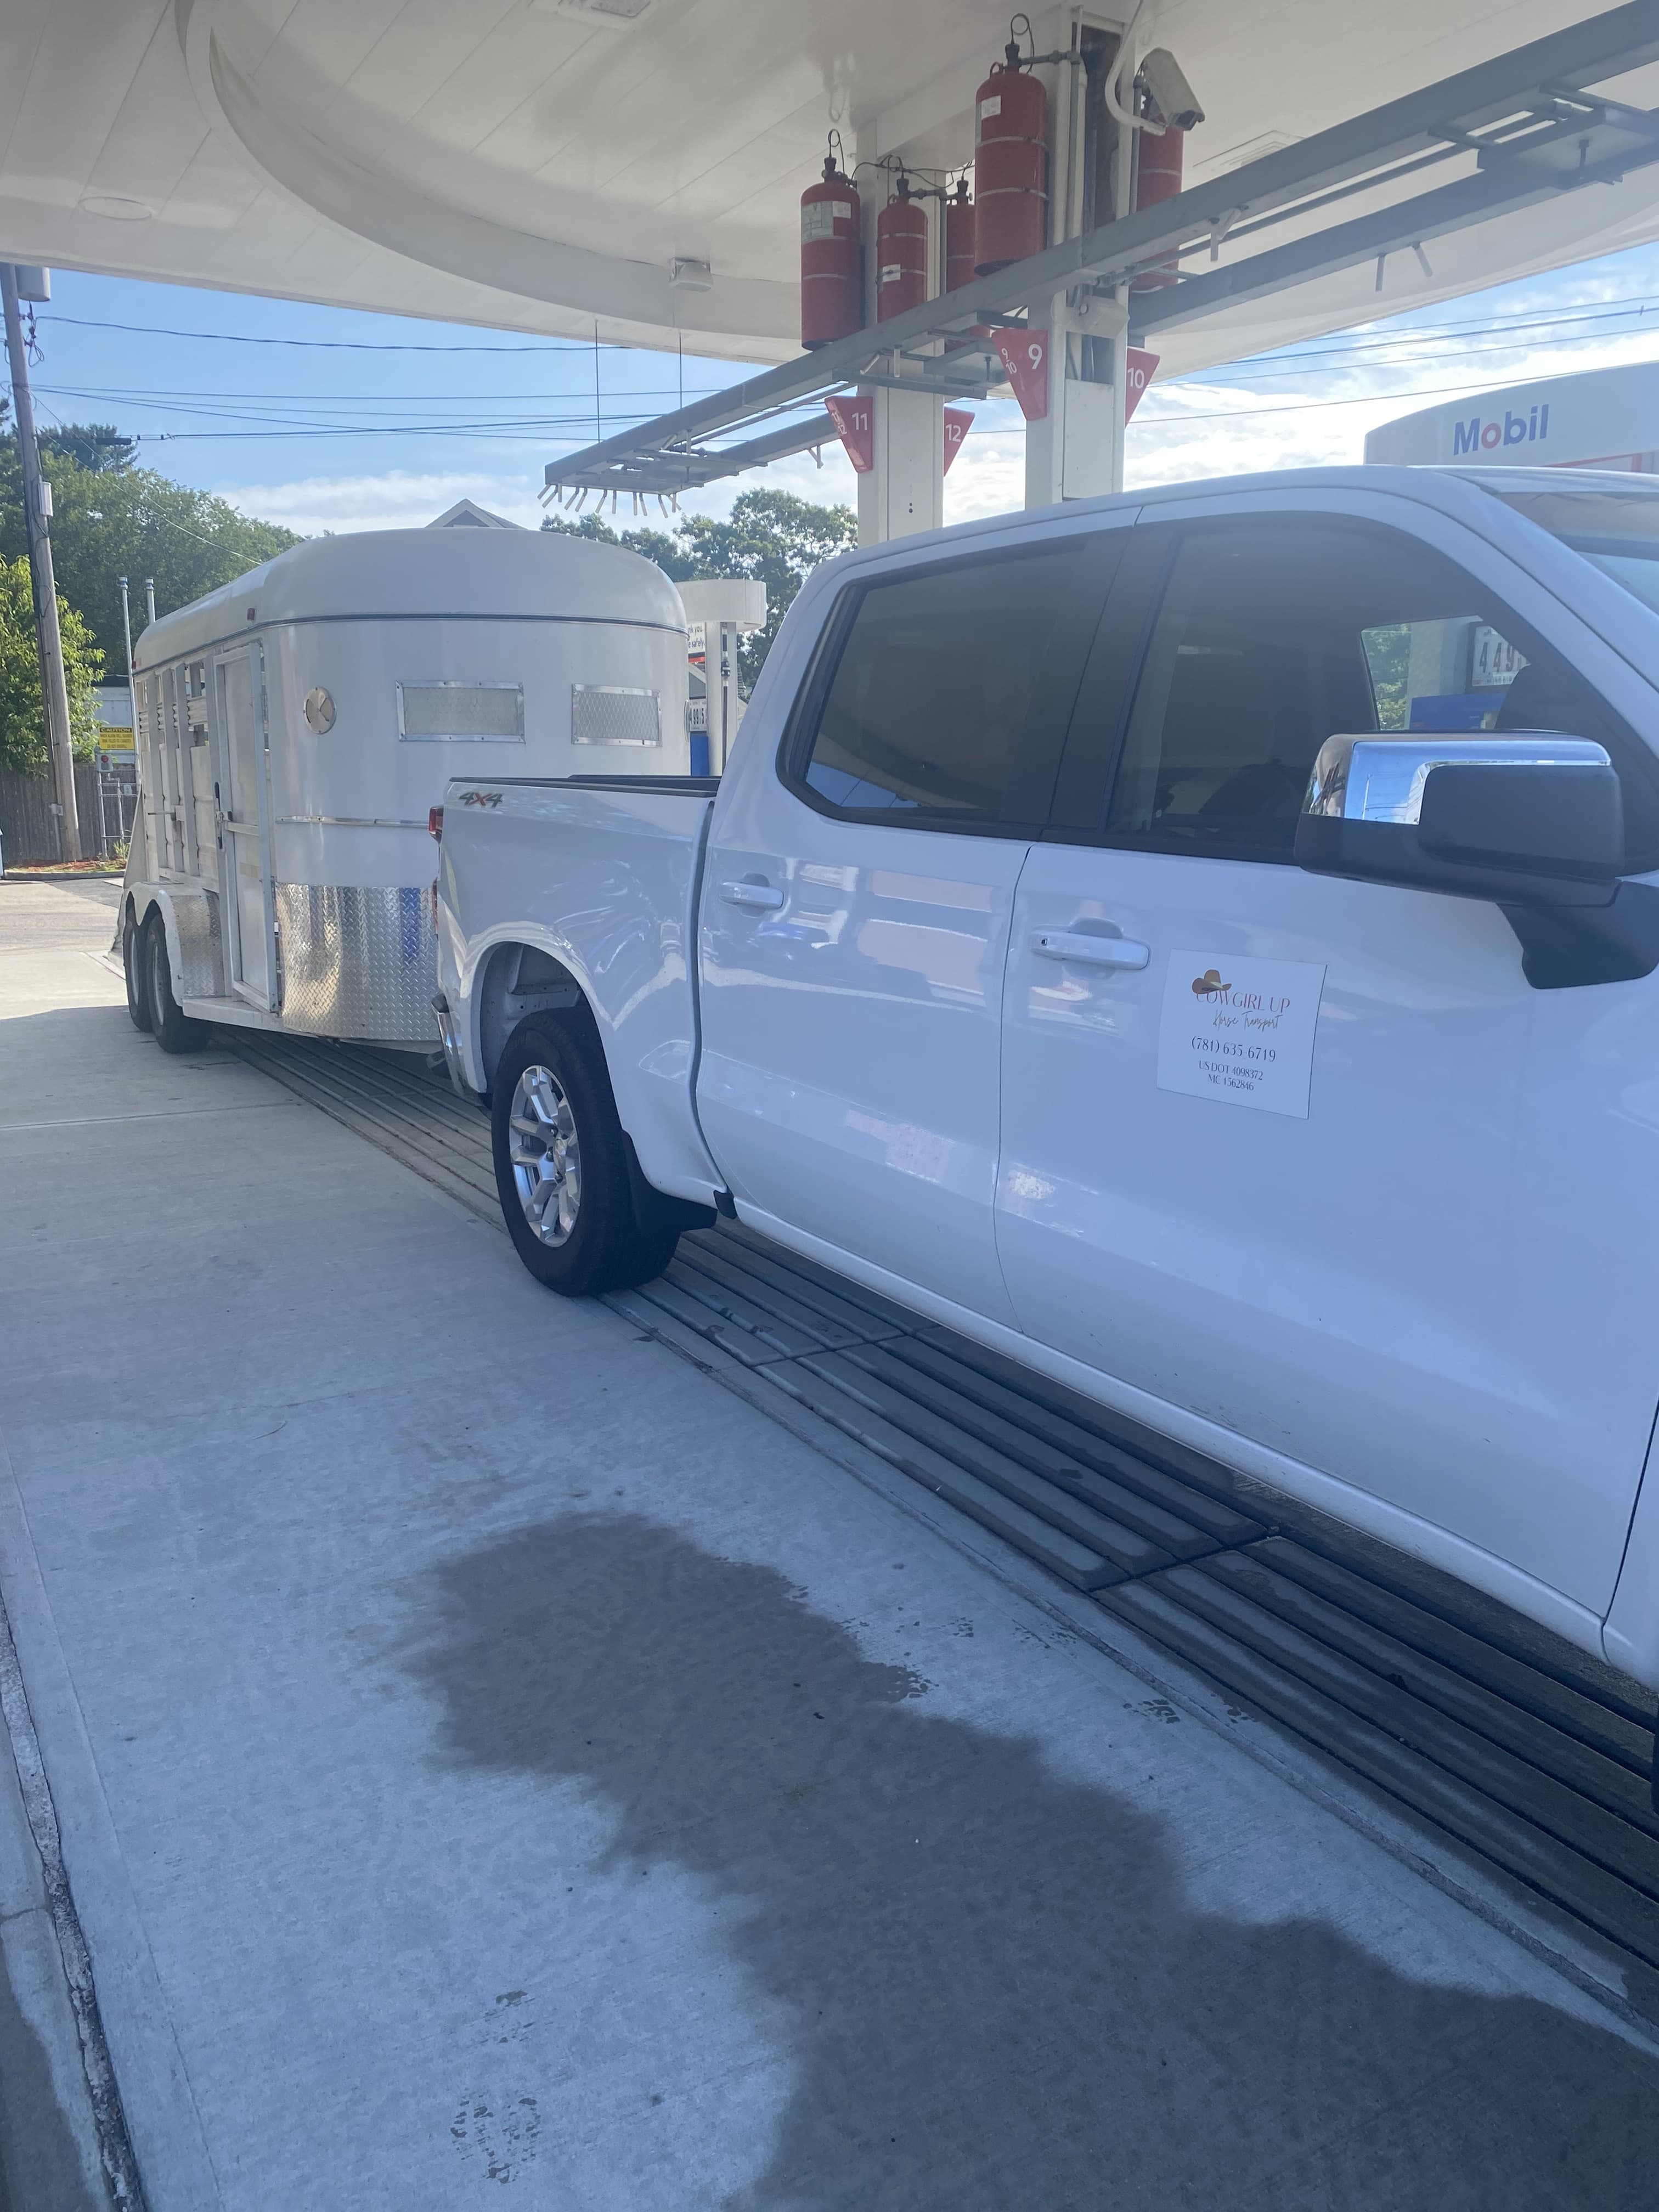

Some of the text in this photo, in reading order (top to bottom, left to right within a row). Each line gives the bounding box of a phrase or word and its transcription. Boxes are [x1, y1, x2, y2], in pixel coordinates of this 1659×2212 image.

[1028, 343, 1042, 369] 9
[1127, 368, 1144, 390] 10
[851, 412, 868, 431] 11
[1453, 404, 1549, 455] Mobil
[946, 424, 961, 442] 12
[1197, 990, 1290, 1013] COWGIRL UP
[1212, 1009, 1284, 1031] Horse Transport
[1192, 1036, 1276, 1063] (781) 635-6719
[1208, 1074, 1254, 1091] MC 1562846
[1232, 1066, 1263, 1080] 4098372
